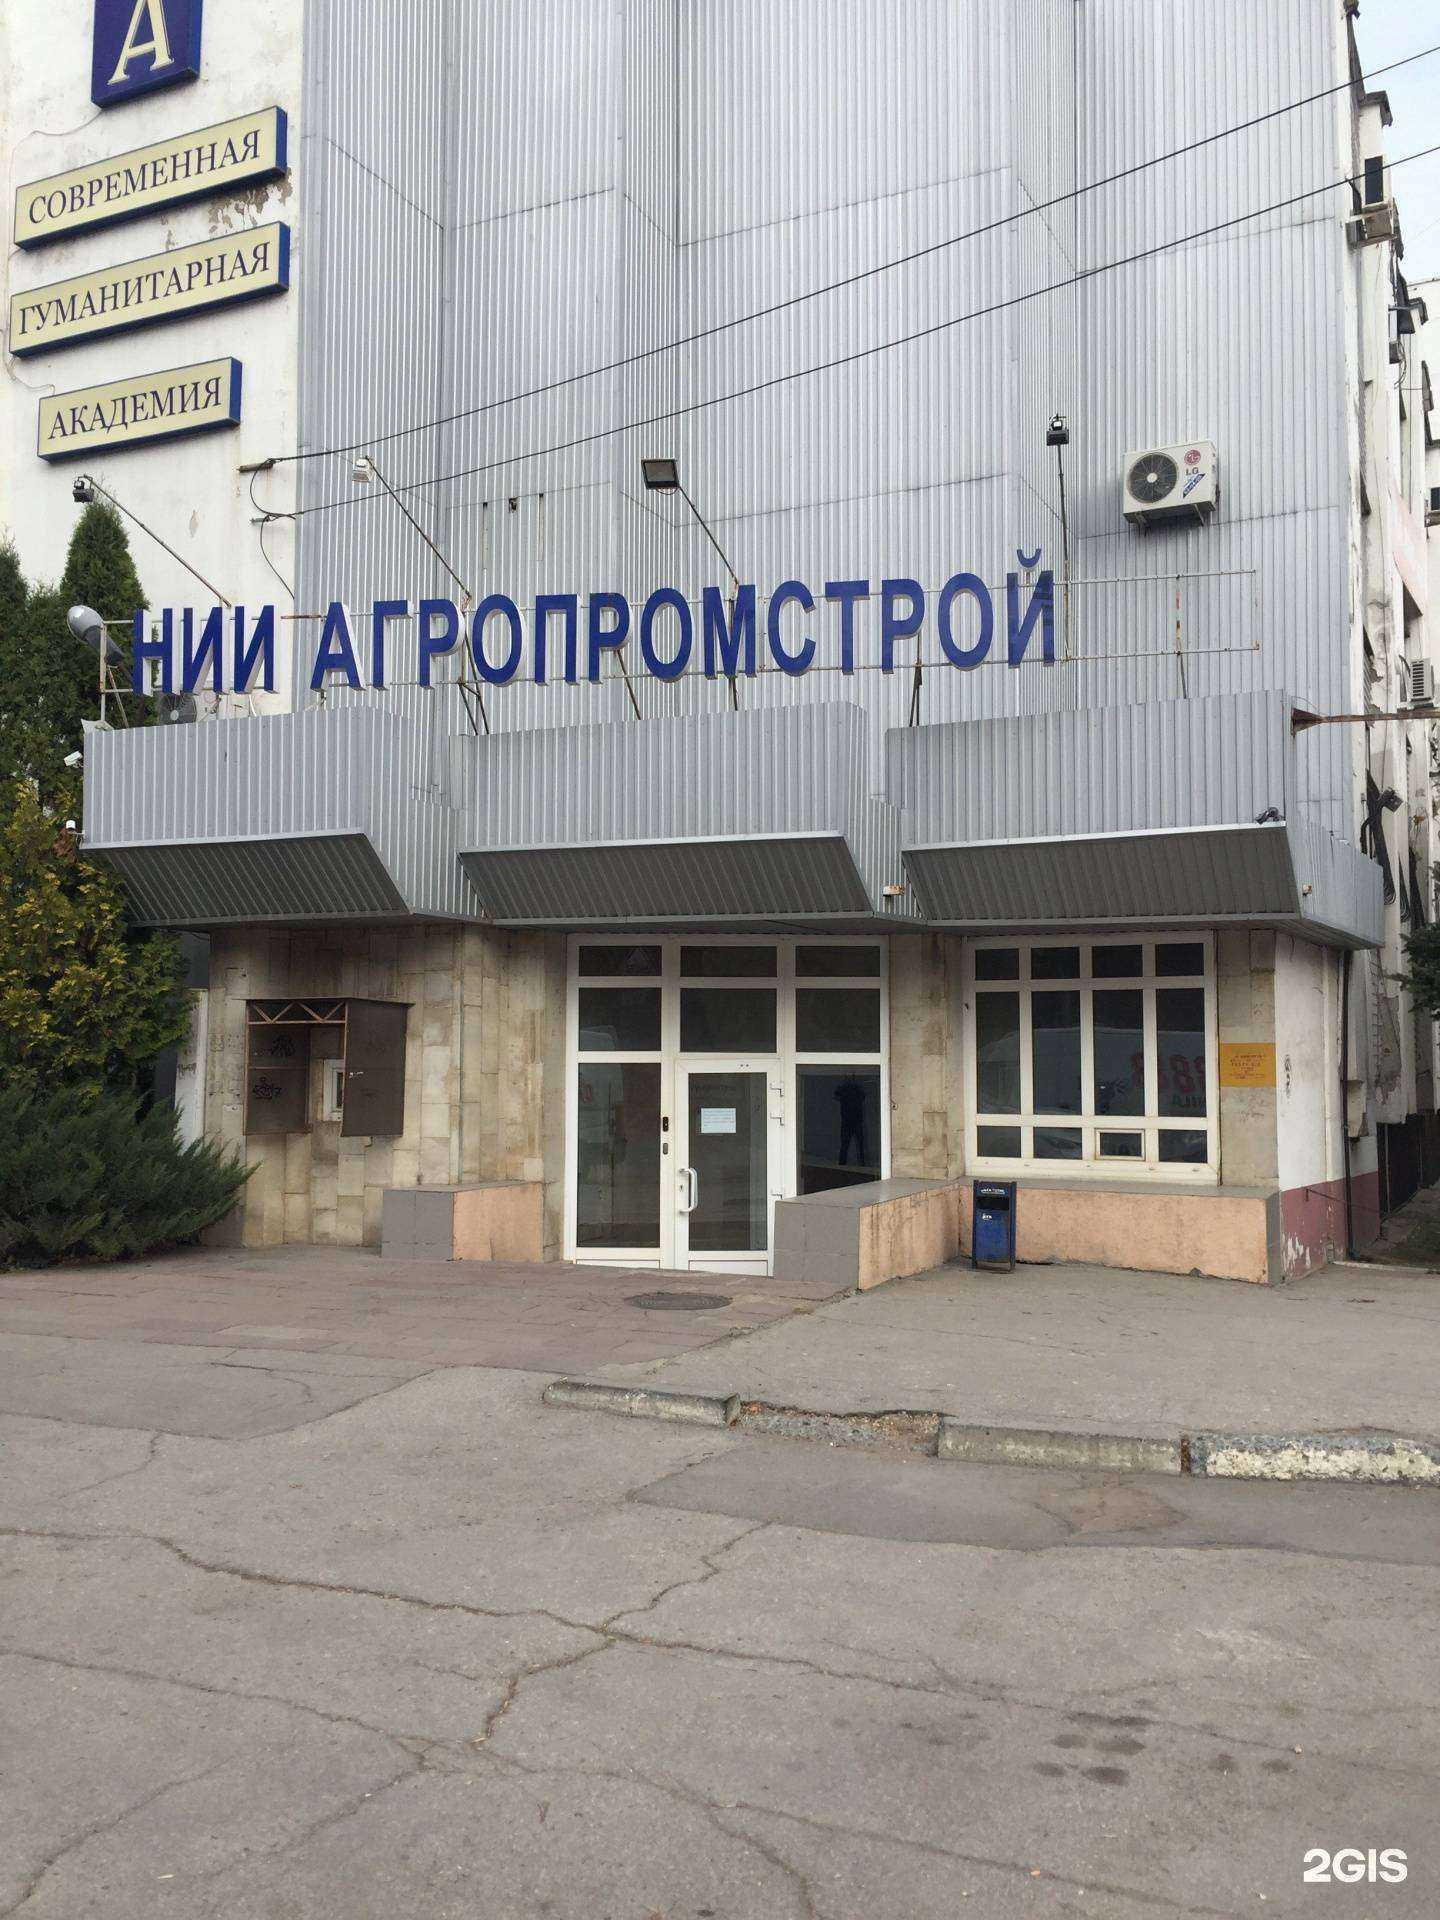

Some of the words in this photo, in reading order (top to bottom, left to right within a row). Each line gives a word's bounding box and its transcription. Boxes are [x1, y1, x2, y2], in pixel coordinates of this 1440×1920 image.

[29, 129, 260, 224] СОВРЕМЕННАЯ
[18, 241, 270, 336] ГУМАНИТАРНАЯ
[47, 376, 222, 440] АКАДЕМИЯ
[1185, 466, 1199, 476] LG
[133, 604, 280, 697] НИИ
[310, 548, 1056, 692] АГРОПРОМСТРОЙ
